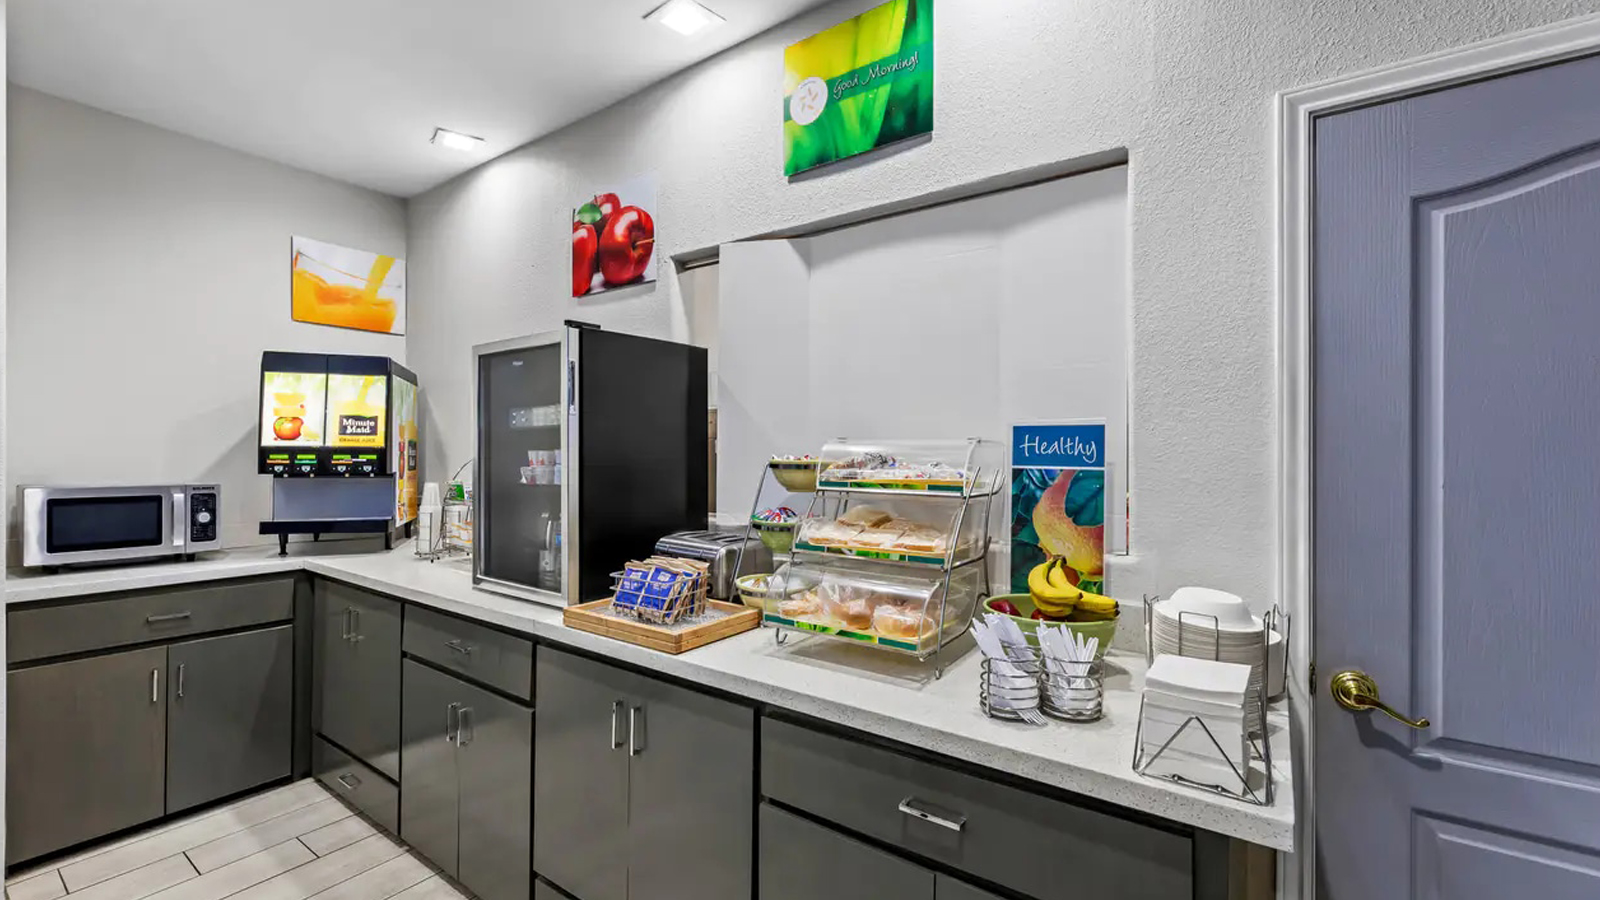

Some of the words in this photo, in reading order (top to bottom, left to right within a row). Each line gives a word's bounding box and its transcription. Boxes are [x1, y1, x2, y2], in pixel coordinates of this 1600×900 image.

[834, 75, 859, 99] Good
[861, 51, 920, 85] Morning!
[342, 418, 375, 427] Minute
[346, 425, 371, 434] Maid
[1019, 435, 1096, 464] Healthy
